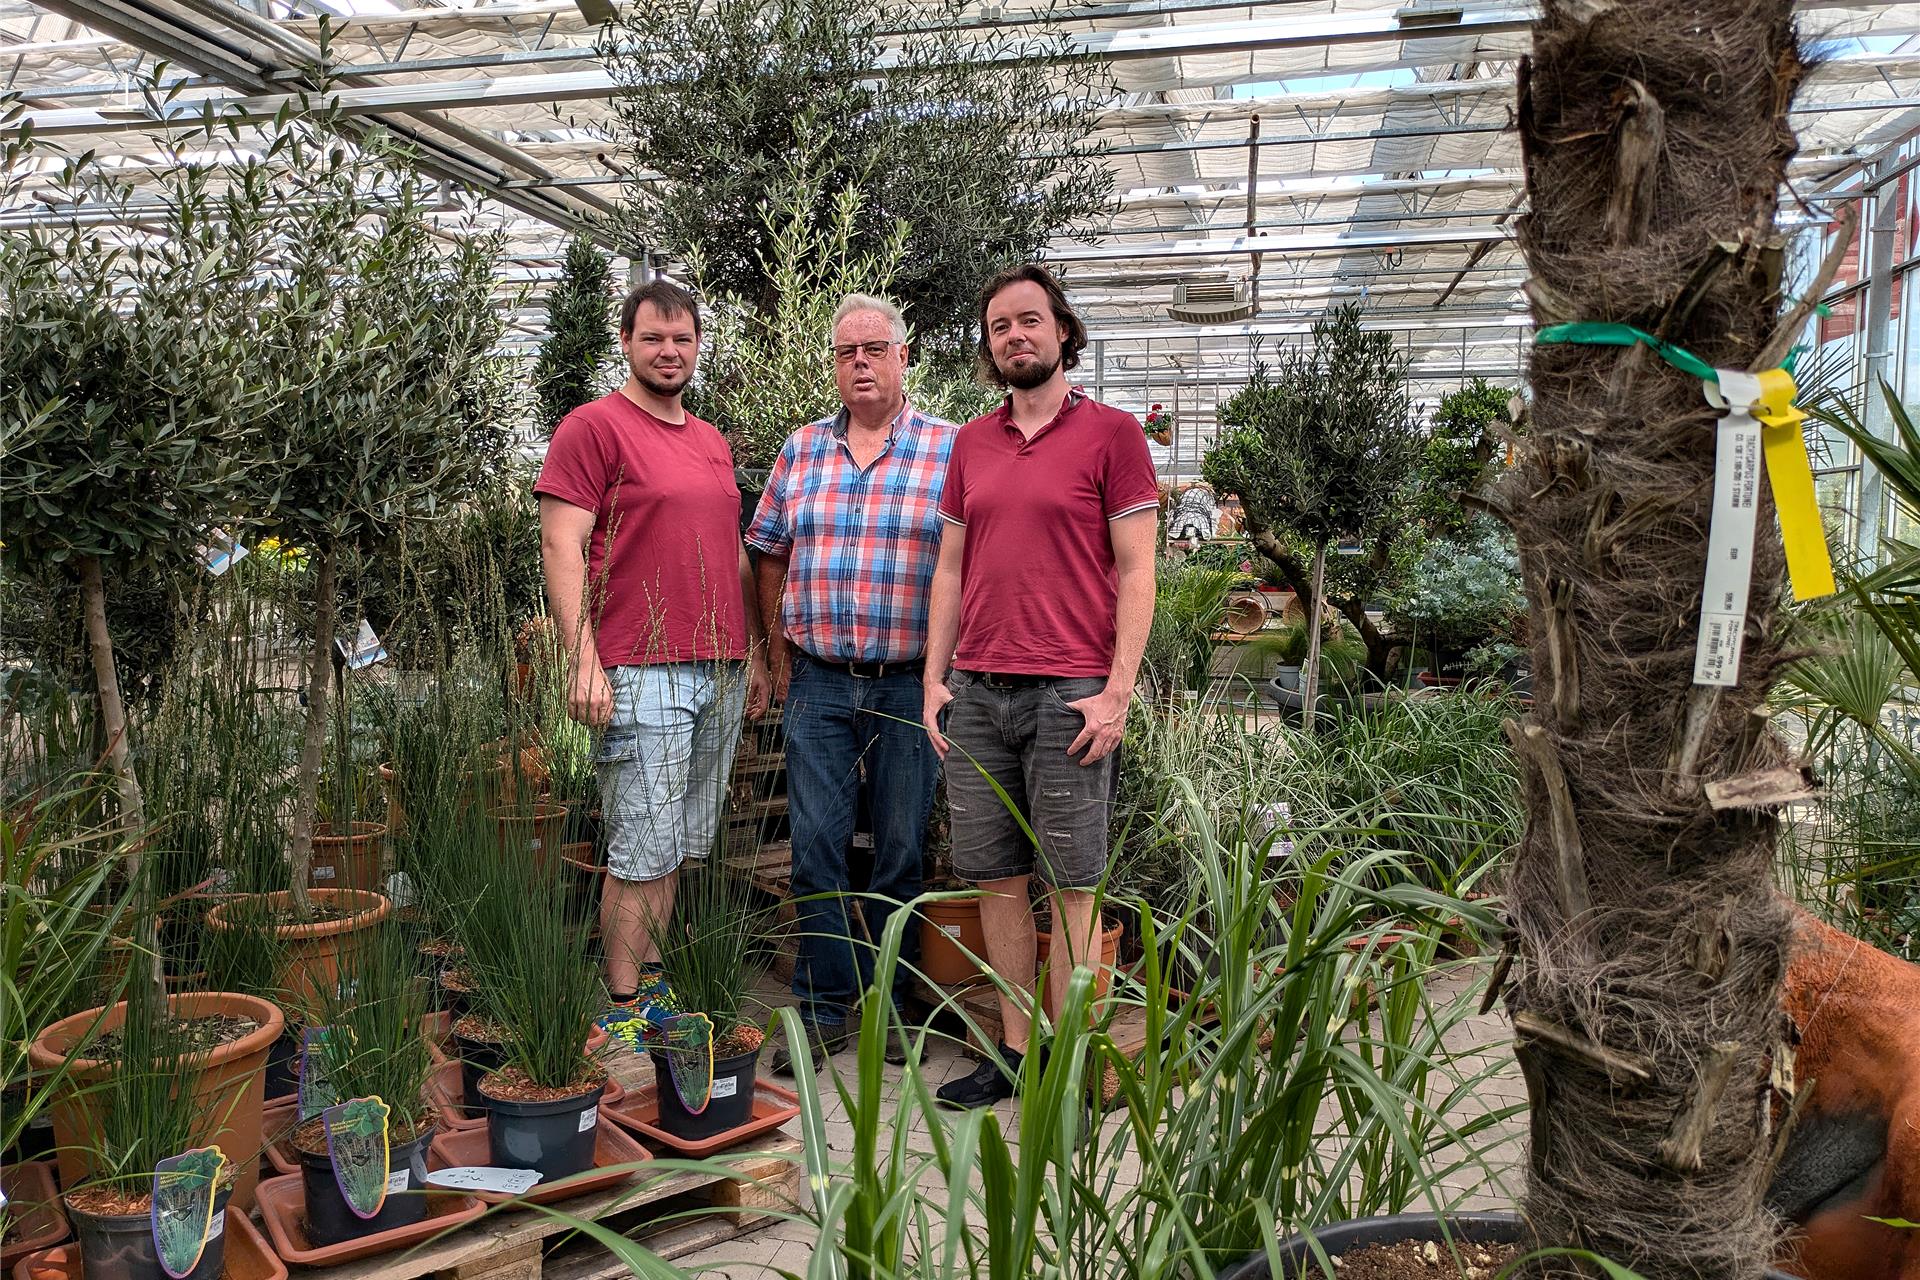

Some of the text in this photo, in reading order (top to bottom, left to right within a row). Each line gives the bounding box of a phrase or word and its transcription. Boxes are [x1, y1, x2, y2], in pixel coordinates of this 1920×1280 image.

[1742, 435, 1756, 508] TRACHYCARPUS FORTUNEI
[1730, 548, 1739, 559] EUR
